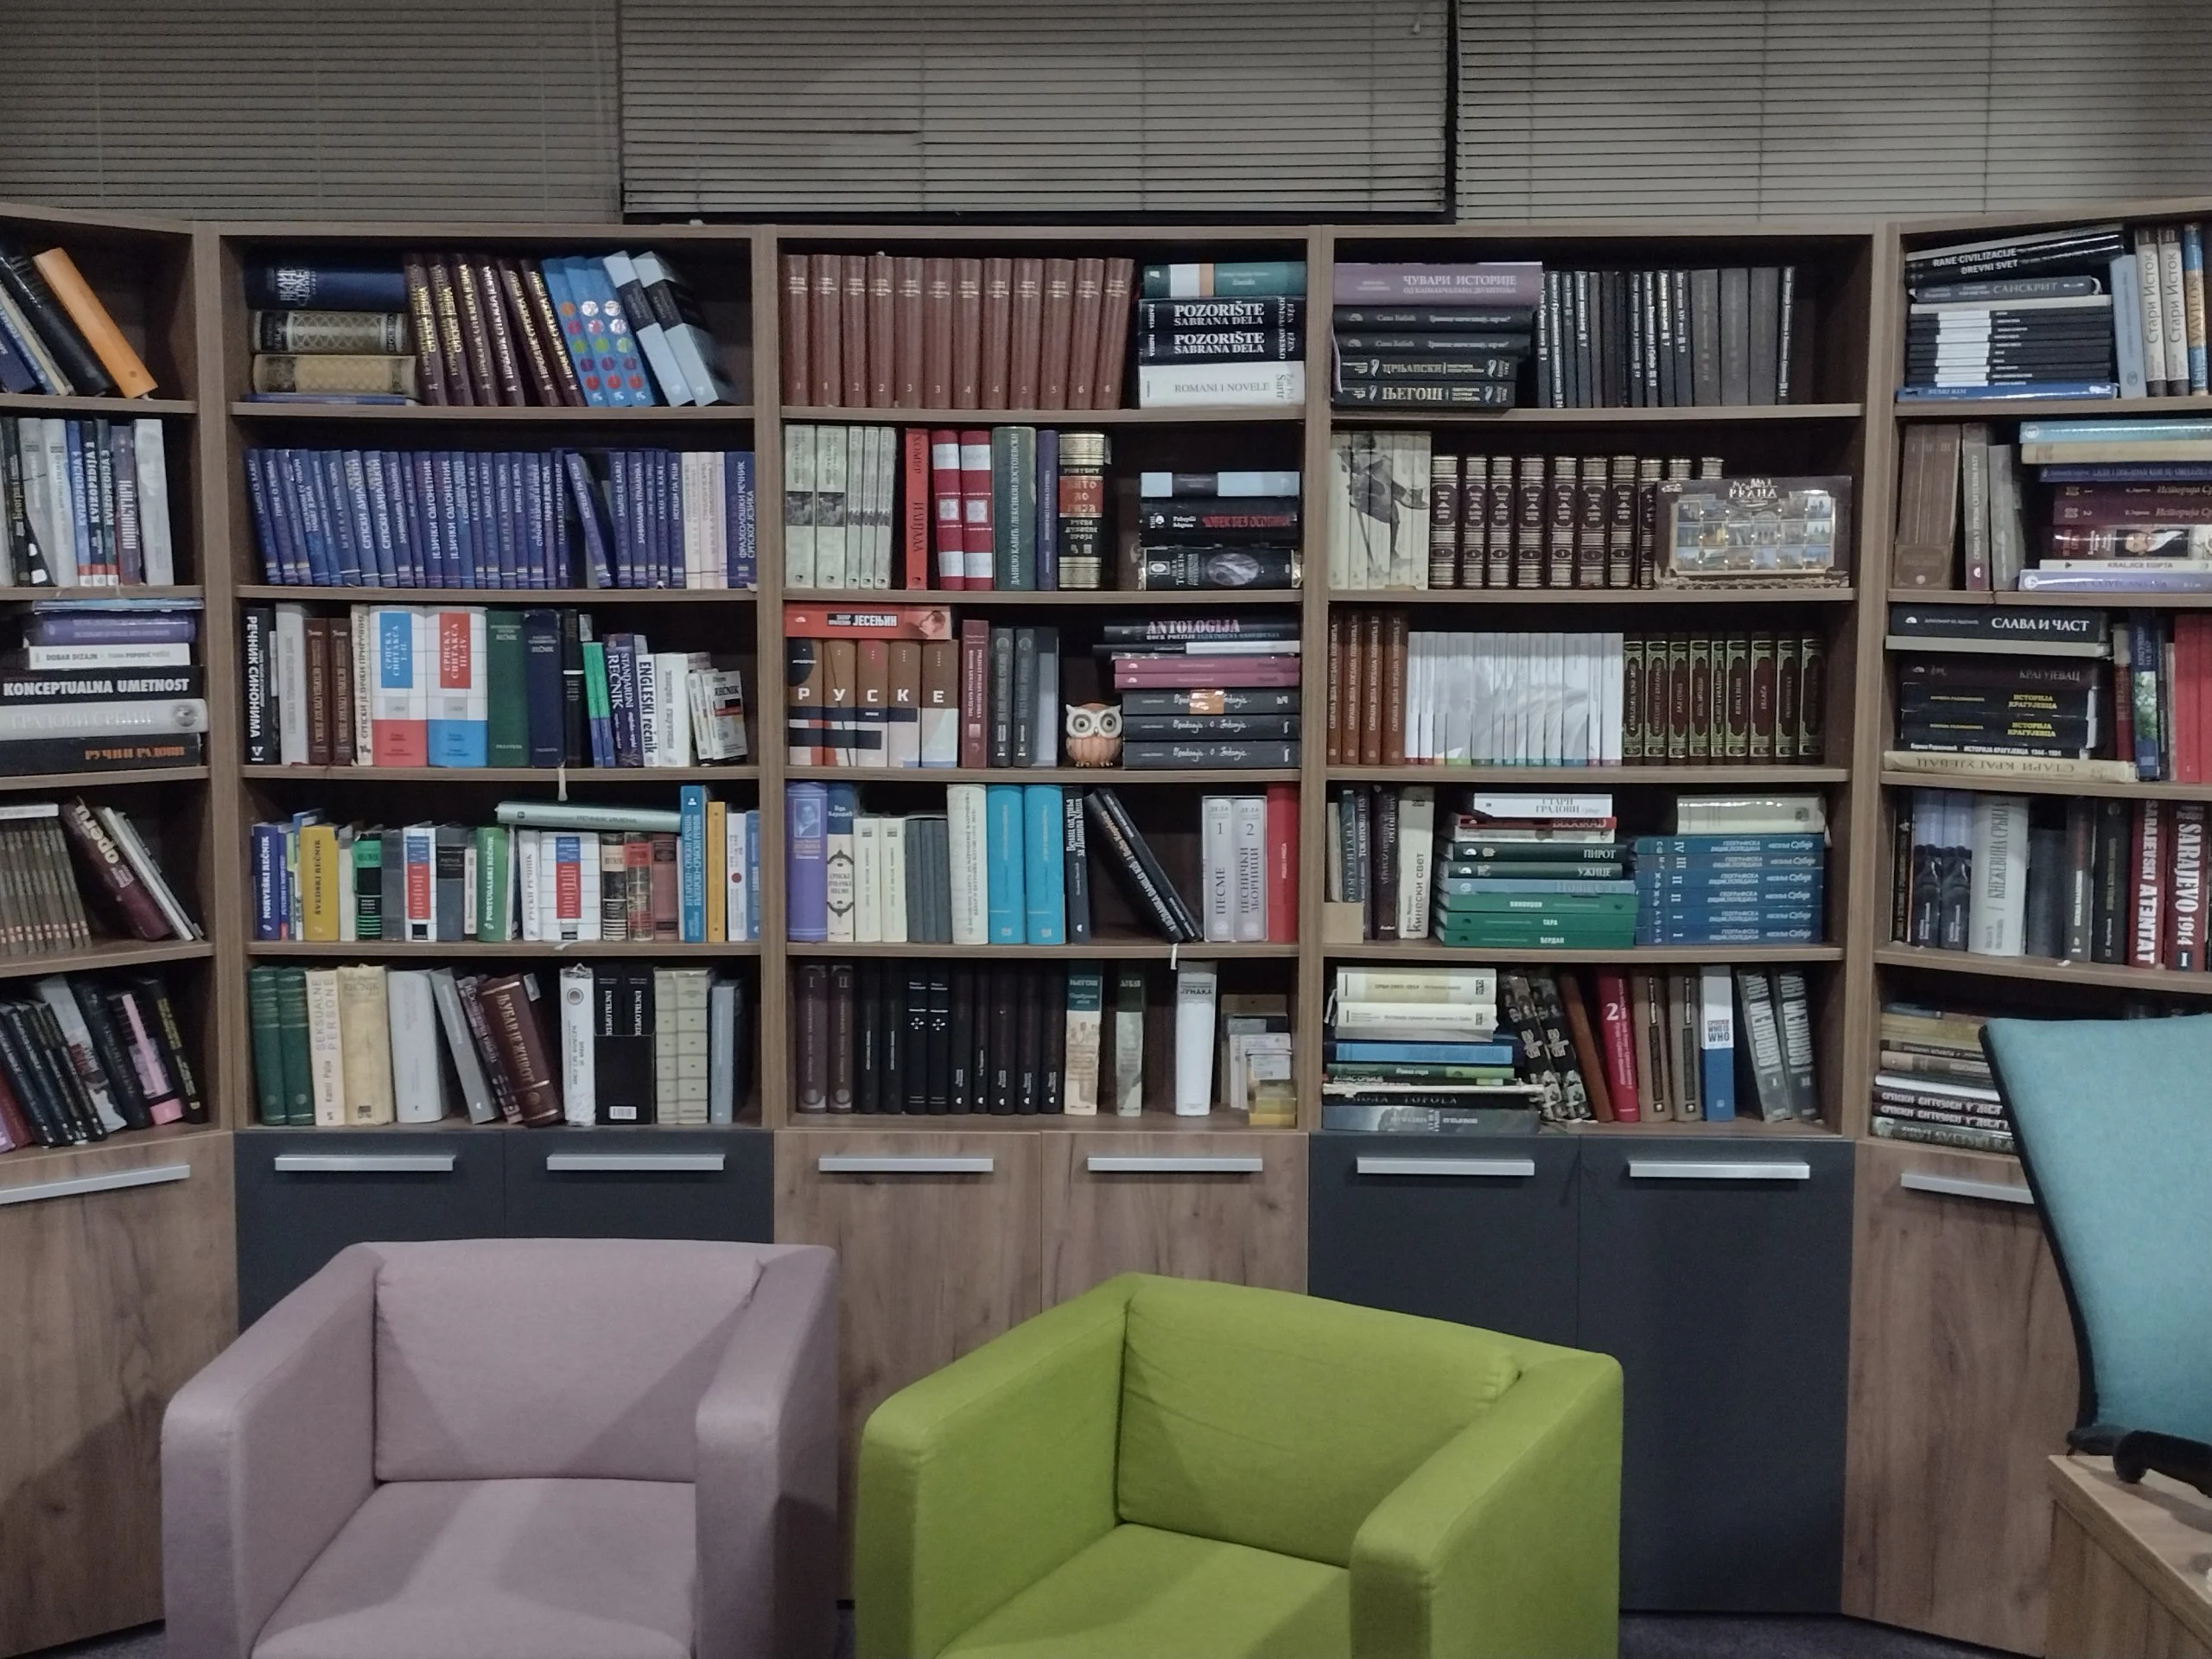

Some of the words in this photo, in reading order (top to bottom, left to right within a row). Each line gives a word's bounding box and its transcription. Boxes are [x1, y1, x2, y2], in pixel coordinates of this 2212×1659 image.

[1958, 248, 2018, 264] CIVILIZACIJE
[1997, 260, 2018, 270] SVET
[1402, 275, 1451, 285] ЧУВАРИ
[1456, 275, 1517, 286] ИСТОРИЈЕ
[1993, 282, 2057, 295] САНСКРИТ
[2143, 254, 2155, 296] Исток
[2165, 252, 2178, 296] Исток
[1173, 300, 1265, 318] POZORIŠTE
[1173, 316, 1229, 327] SABRANA
[1232, 315, 1263, 326] DELA
[2144, 301, 2161, 344] Стари
[2167, 300, 2183, 343] Стари
[1173, 331, 1265, 346] POZORIŠTE
[1173, 345, 1229, 355] SABRANA
[1231, 344, 1265, 354] DELA
[1174, 385, 1218, 395] ROMANI
[1226, 382, 1269, 392] NOVELE
[1382, 386, 1444, 402] ЊЕГОШ
[73, 458, 87, 526] KVIZOPEDIJA
[86, 451, 100, 523] KVIZOPEDIJA
[102, 455, 116, 526] KVIZOPEDIJA
[351, 459, 367, 511] ДИЈАЛЕКТИ
[372, 459, 387, 511] ДИЈАЛЕКТИ
[423, 460, 438, 519] ОДГОНЕТНИК
[442, 460, 455, 519] ОДГОНЕТНИК
[736, 461, 747, 494] РЕЧНИК
[1728, 487, 1778, 499] PRAHA
[746, 490, 755, 523] ЈЕЗИКА
[357, 513, 372, 550] СРПСКИ
[378, 513, 392, 550] СРПСКИ
[429, 521, 442, 560] ЈЕЗИЧКИ
[448, 521, 461, 560] ЈЕЗИЧКИ
[737, 494, 750, 559] ФРАЗЕОЛОШКИ
[747, 524, 756, 559] СРПСКОГ
[852, 614, 897, 627] ЈЕСЕЊИН
[1147, 620, 1241, 634] ANTOLOGIJA
[1991, 617, 2037, 630] СЛАВА
[2039, 619, 2050, 630] И
[2052, 619, 2090, 632] ЧАСТ
[246, 615, 259, 664] РЕЧНИК
[385, 632, 393, 670] СРПСКА
[391, 625, 400, 677] СИНТАКСА
[442, 630, 451, 671] СРПСКА
[450, 623, 460, 680] СИНТАКСА
[3, 680, 115, 697] KONCEPTUALNA
[118, 677, 191, 694] UMETNOST
[622, 652, 634, 709] STANDARDNI
[639, 661, 656, 715] ENGLESKI
[2018, 669, 2082, 683] КРАГУЈЕВАЦ
[248, 666, 262, 739] СИНОНИМА
[641, 718, 658, 754] rečnik
[1916, 757, 2014, 770] КРАГУЈЕВАЦ
[2022, 761, 2075, 772] СТАРИ
[1535, 804, 1580, 814] ГРАДОВИ
[1217, 822, 1224, 836] 1
[1245, 823, 1255, 836] 2
[2140, 799, 2159, 881] SARAJEVSKI
[260, 836, 270, 871] REČNIK
[311, 839, 321, 874] REČNIK
[484, 836, 495, 867] REČNIK
[1414, 852, 1426, 879] свет
[1583, 849, 1617, 859] ПИРОТ
[1673, 842, 1685, 854] IV
[1675, 856, 1687, 869] III
[524, 854, 534, 889] РЕЧНИК
[1239, 847, 1249, 914] ПЕСНИЧКИ
[1249, 848, 1259, 912] ЗБОРНИЦИ
[1577, 867, 1611, 877] УЖИЦЕ
[1672, 874, 1683, 885] II
[1986, 840, 2010, 899] КНЕЖЕВИНА
[2174, 823, 2202, 913] SARAJEVO
[261, 872, 273, 919] NORVEŠKI
[312, 875, 322, 916] ŠVEDSKI
[484, 867, 495, 922] PORTUGALSKI
[526, 890, 536, 921] РУСКИ
[1215, 867, 1226, 915] ПЕСМЕ
[1407, 881, 1423, 932] Кинески
[1670, 893, 1682, 903] II
[2136, 884, 2158, 965] ATENTAT
[2176, 915, 2196, 947] 1914
[839, 976, 850, 988] II
[311, 979, 327, 1052] SEKSUALNE
[324, 979, 339, 1051] PERSONE
[1606, 1001, 1619, 1020] 2
[497, 994, 520, 1030] ЉУБАВ
[512, 1042, 535, 1083] ЖИВОТ
[1707, 1033, 1730, 1043] WHO
